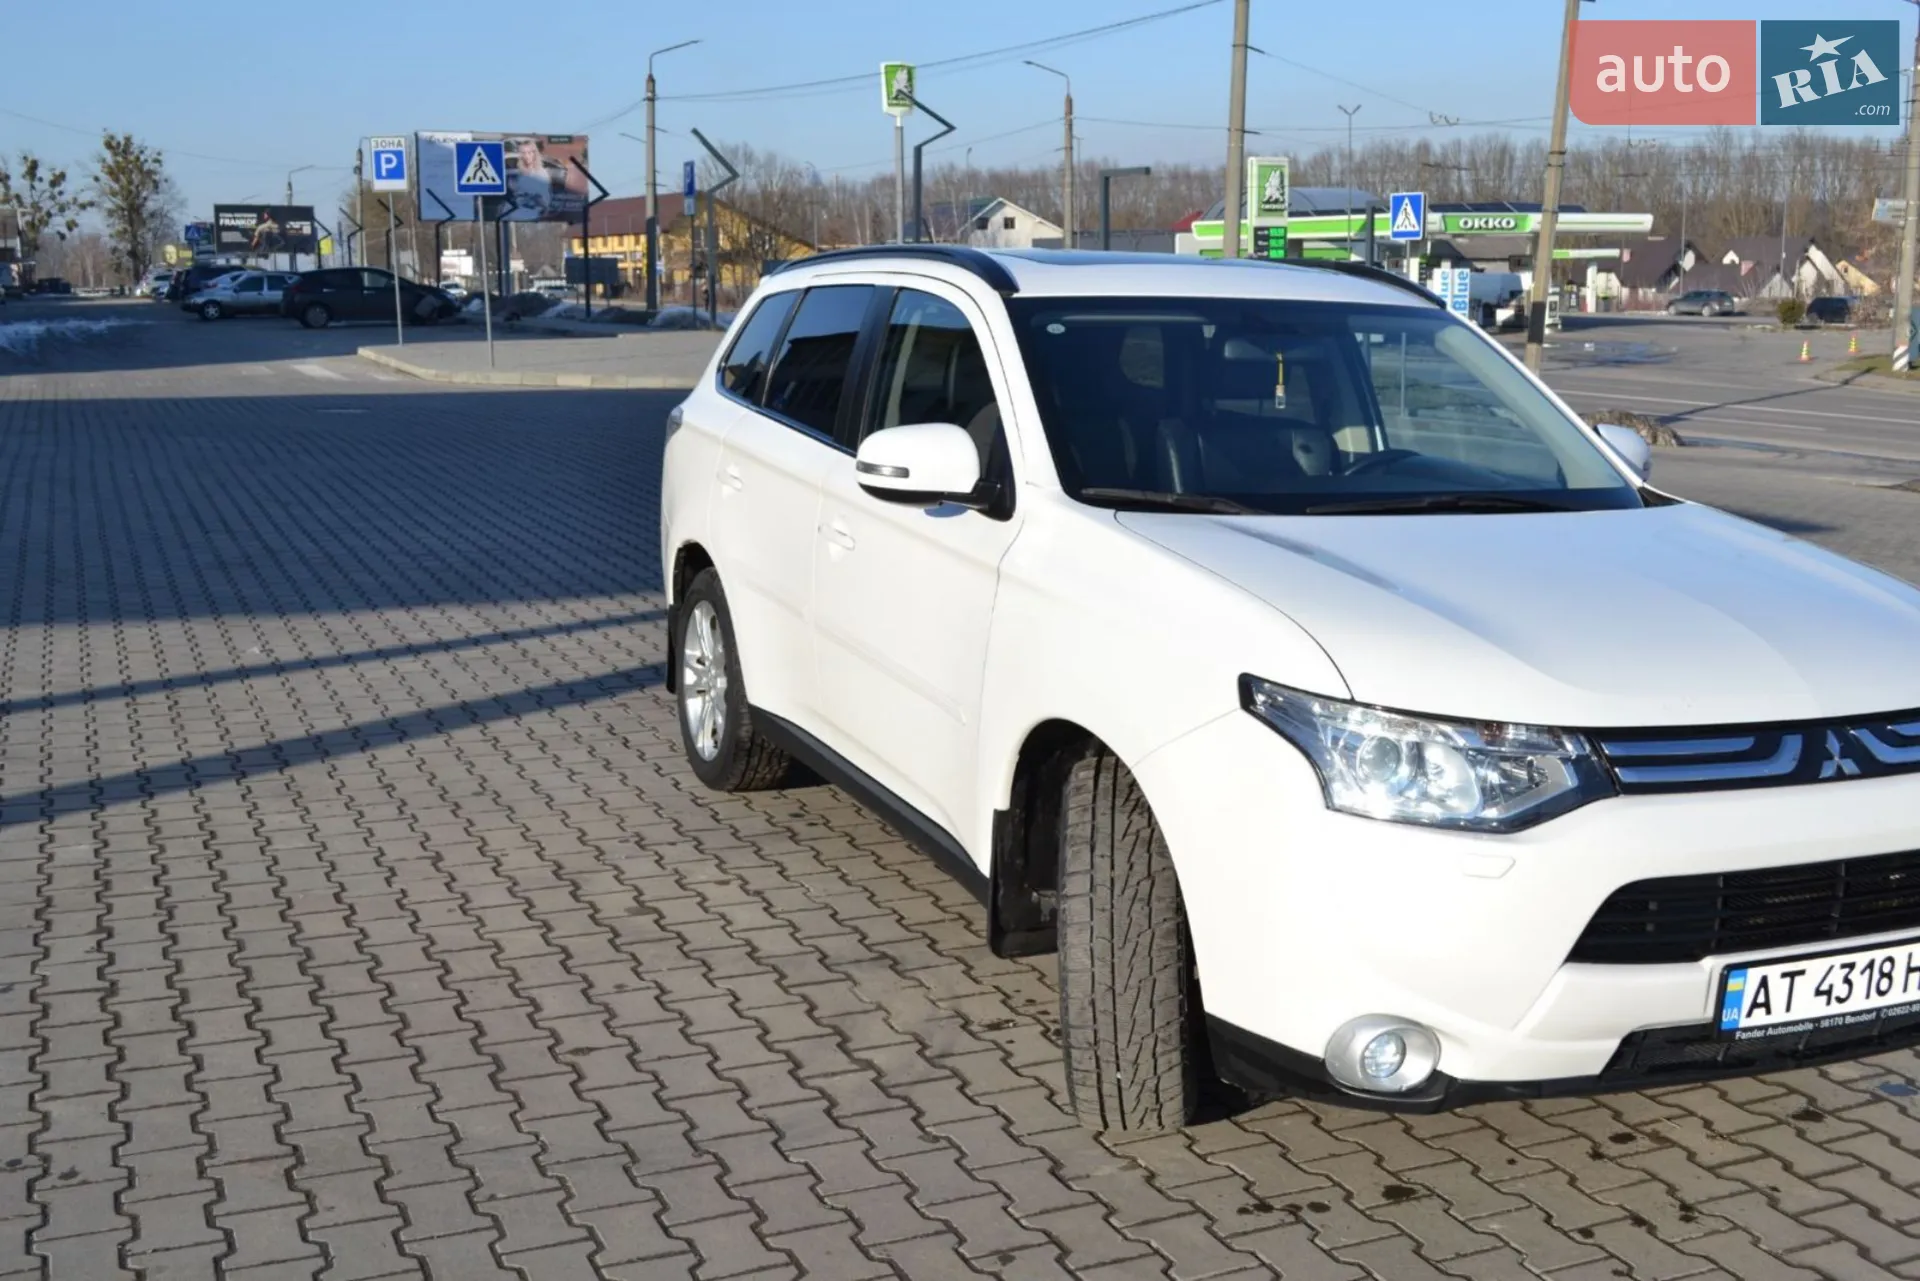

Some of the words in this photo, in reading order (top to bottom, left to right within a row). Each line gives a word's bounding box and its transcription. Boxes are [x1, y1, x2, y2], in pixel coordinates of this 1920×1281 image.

[372, 139, 404, 149] ЗОНА
[380, 152, 398, 178] P
[1459, 216, 1516, 230] OKKO
[1452, 270, 1469, 314] Blue
[1745, 968, 1807, 1019] AT
[1813, 955, 1896, 1007] 4318
[1722, 1008, 1739, 1022] UA
[1735, 1028, 1765, 1040] Fander
[1766, 1022, 1814, 1036] Automobile
